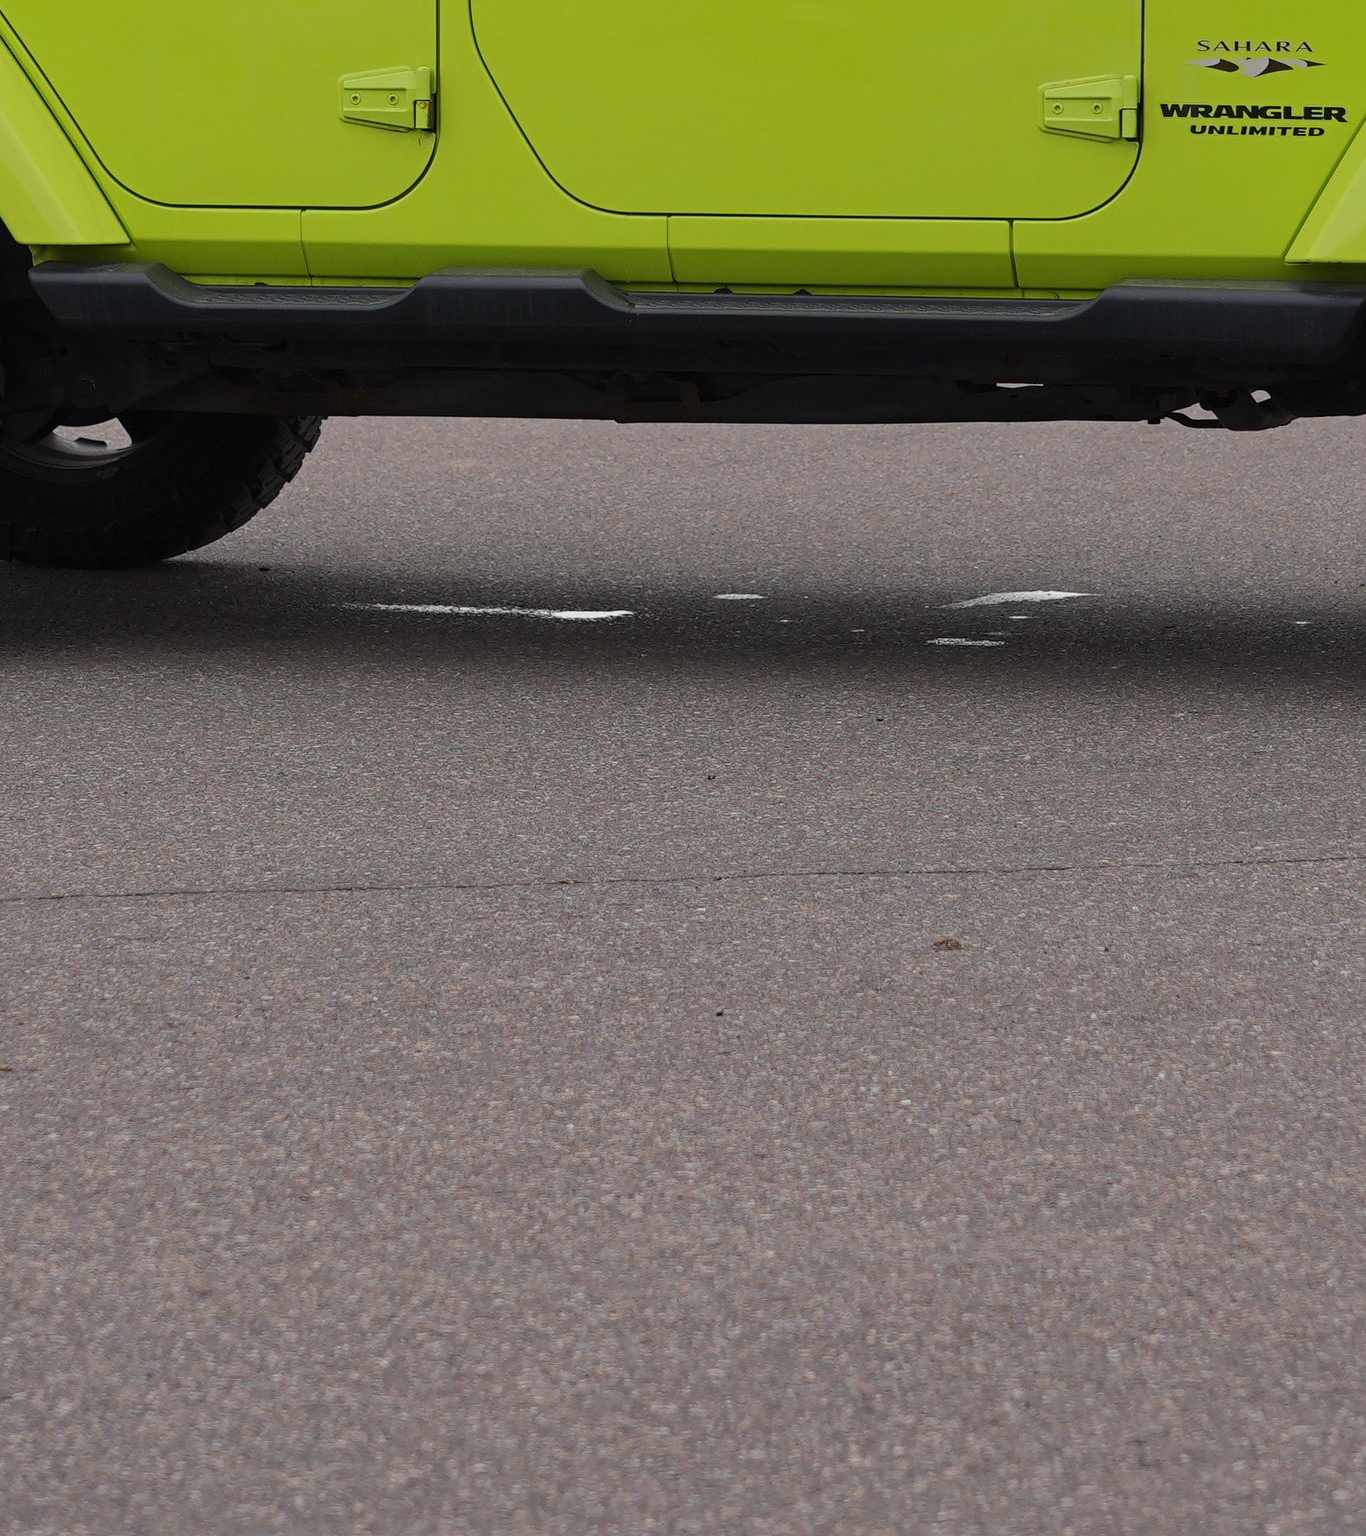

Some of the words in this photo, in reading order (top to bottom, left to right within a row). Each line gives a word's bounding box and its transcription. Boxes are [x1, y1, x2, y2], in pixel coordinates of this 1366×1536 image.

[1197, 39, 1314, 53] SAHARA
[1159, 103, 1348, 123] WRANGLER
[1190, 124, 1325, 137] UNLIMITED
